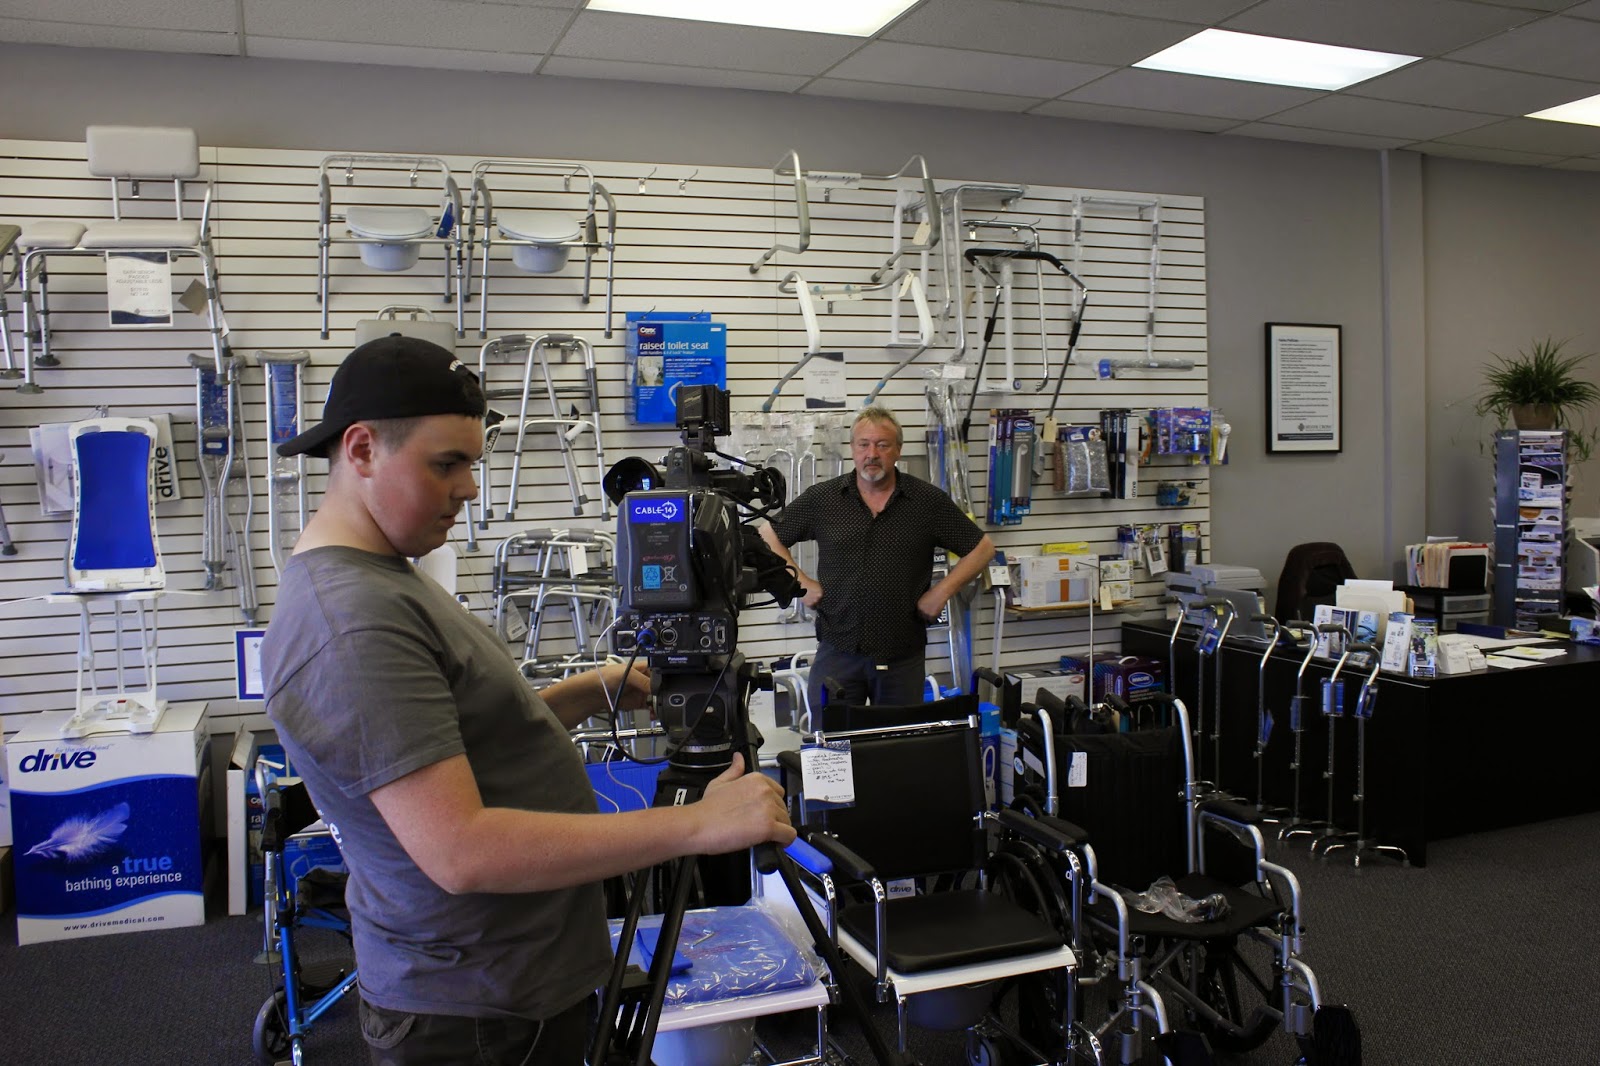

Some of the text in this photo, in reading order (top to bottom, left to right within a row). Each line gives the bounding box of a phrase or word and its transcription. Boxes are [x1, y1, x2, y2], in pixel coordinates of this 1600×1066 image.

[639, 341, 709, 350] raised toilet seat
[155, 446, 173, 498] drive
[635, 506, 673, 515] CABLE 14
[19, 748, 97, 773] drive
[676, 790, 684, 805] 1
[111, 856, 172, 875] a true
[65, 871, 182, 892] bathing experience
[889, 885, 912, 893] drive
[64, 915, 165, 931] www.drivemedical.com
